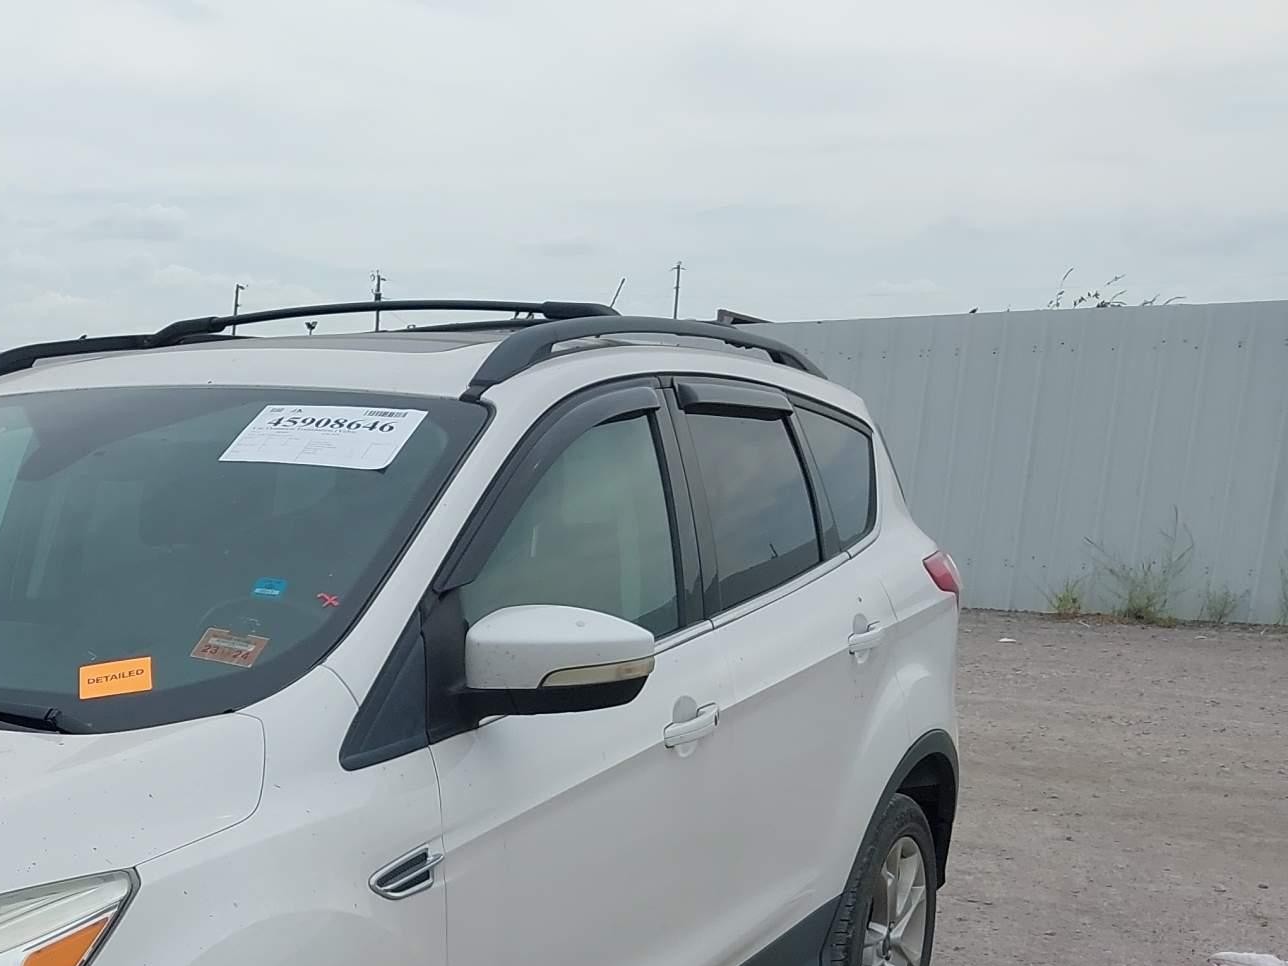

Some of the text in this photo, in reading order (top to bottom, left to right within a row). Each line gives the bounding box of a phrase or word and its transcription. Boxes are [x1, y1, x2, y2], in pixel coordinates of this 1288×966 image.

[267, 416, 398, 432] 45908646
[200, 644, 219, 655] 23
[87, 668, 145, 685] DETAILED
